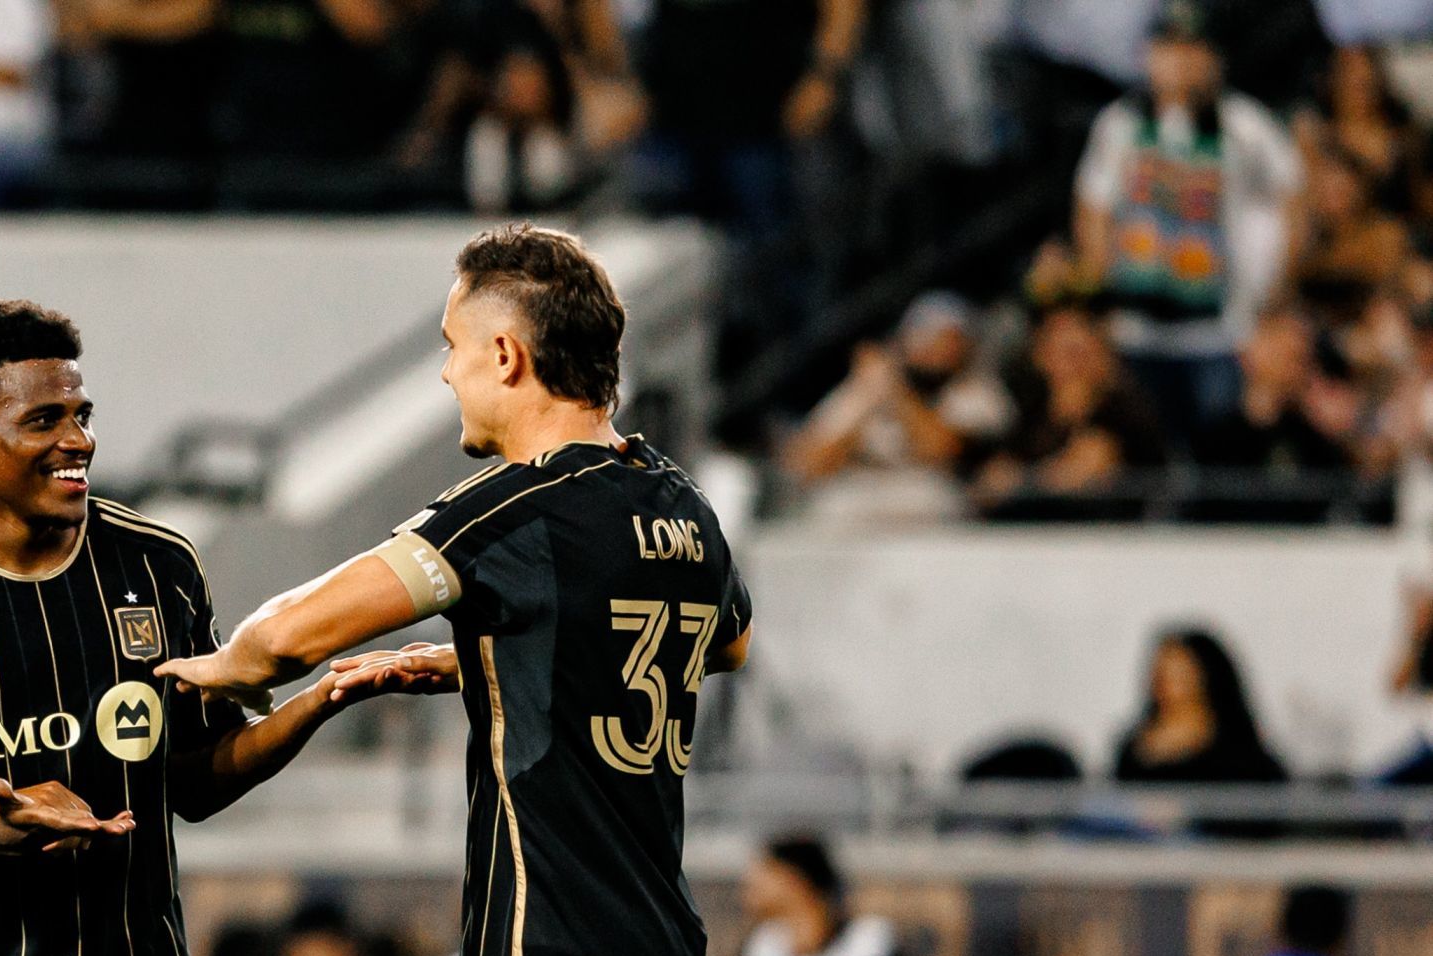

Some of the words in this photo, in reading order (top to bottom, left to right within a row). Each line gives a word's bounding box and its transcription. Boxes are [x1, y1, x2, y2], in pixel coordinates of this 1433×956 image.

[632, 515, 704, 562] LONG
[411, 547, 449, 602] LAFD
[590, 599, 719, 776] 33
